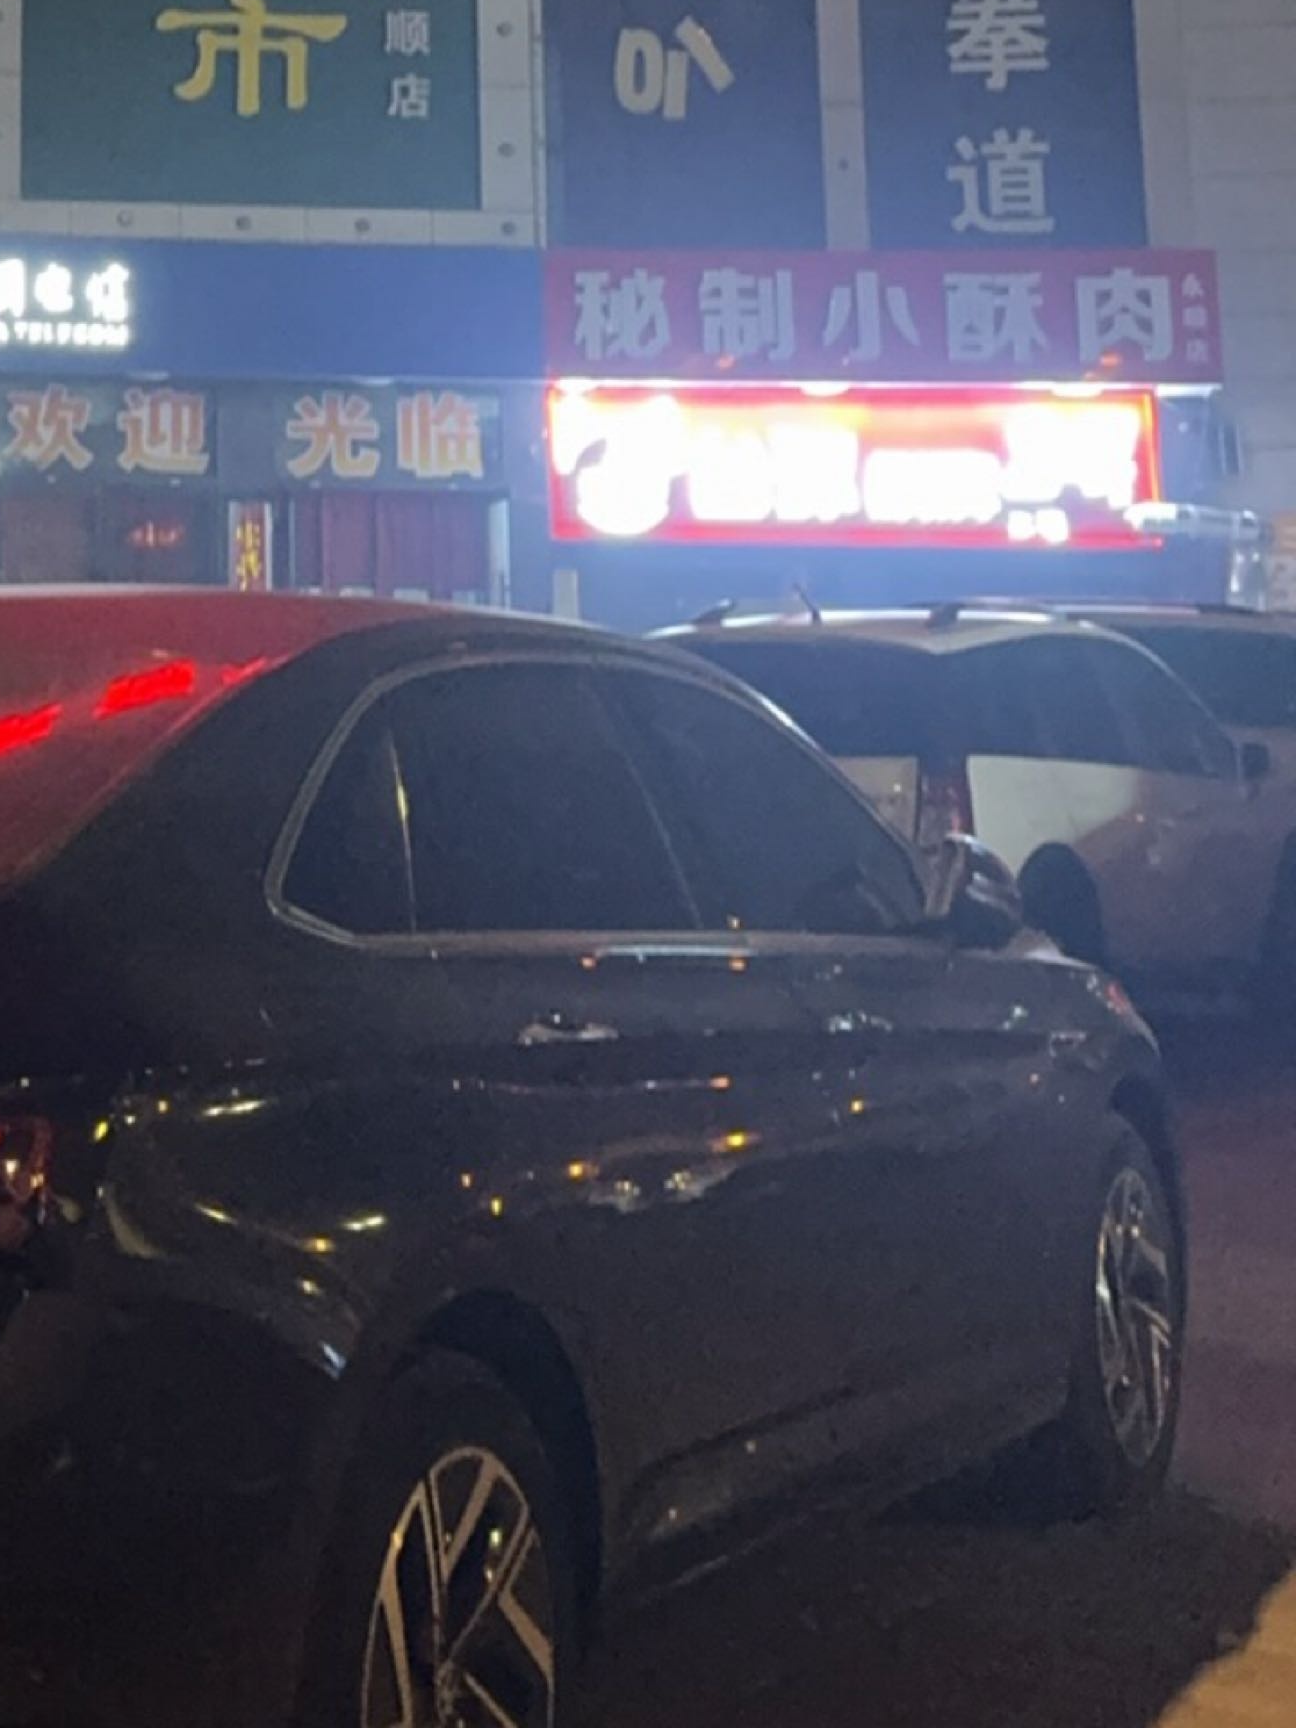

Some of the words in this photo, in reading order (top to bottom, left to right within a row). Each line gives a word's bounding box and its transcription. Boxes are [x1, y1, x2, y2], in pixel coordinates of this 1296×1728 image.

[574, 268, 1174, 364] 秘制小酥肉
[5, 384, 209, 475] 欢迎
[287, 390, 484, 480] 光临
